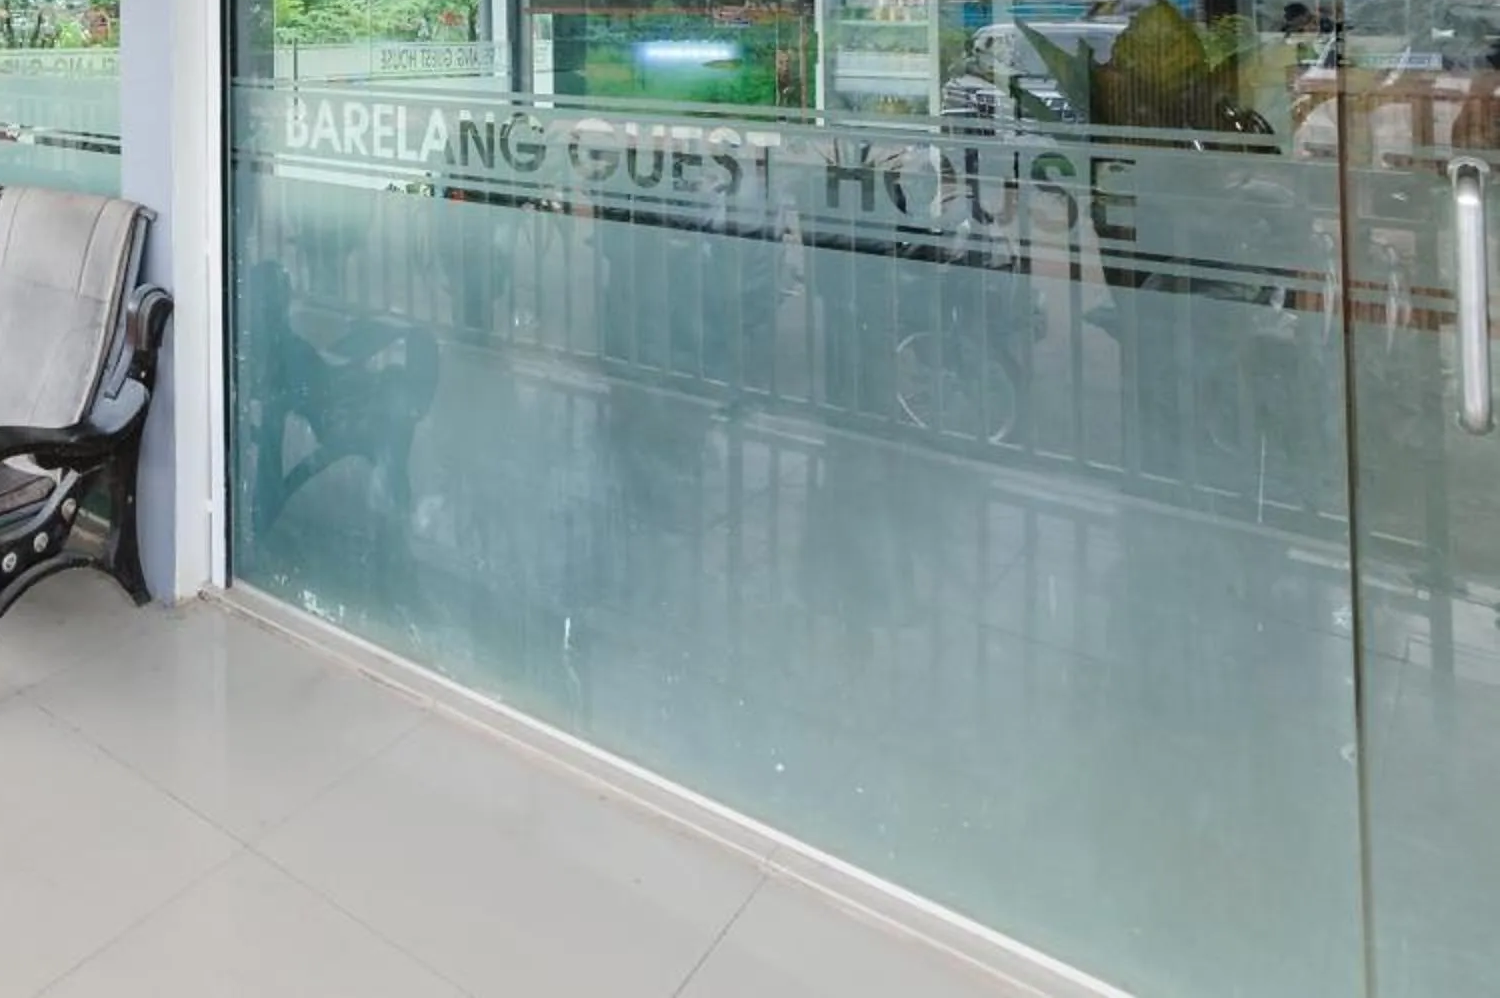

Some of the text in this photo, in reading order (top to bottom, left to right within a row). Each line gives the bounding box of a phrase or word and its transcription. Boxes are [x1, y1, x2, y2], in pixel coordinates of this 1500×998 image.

[286, 97, 1137, 242] BARELANG GUEST HOUSE
